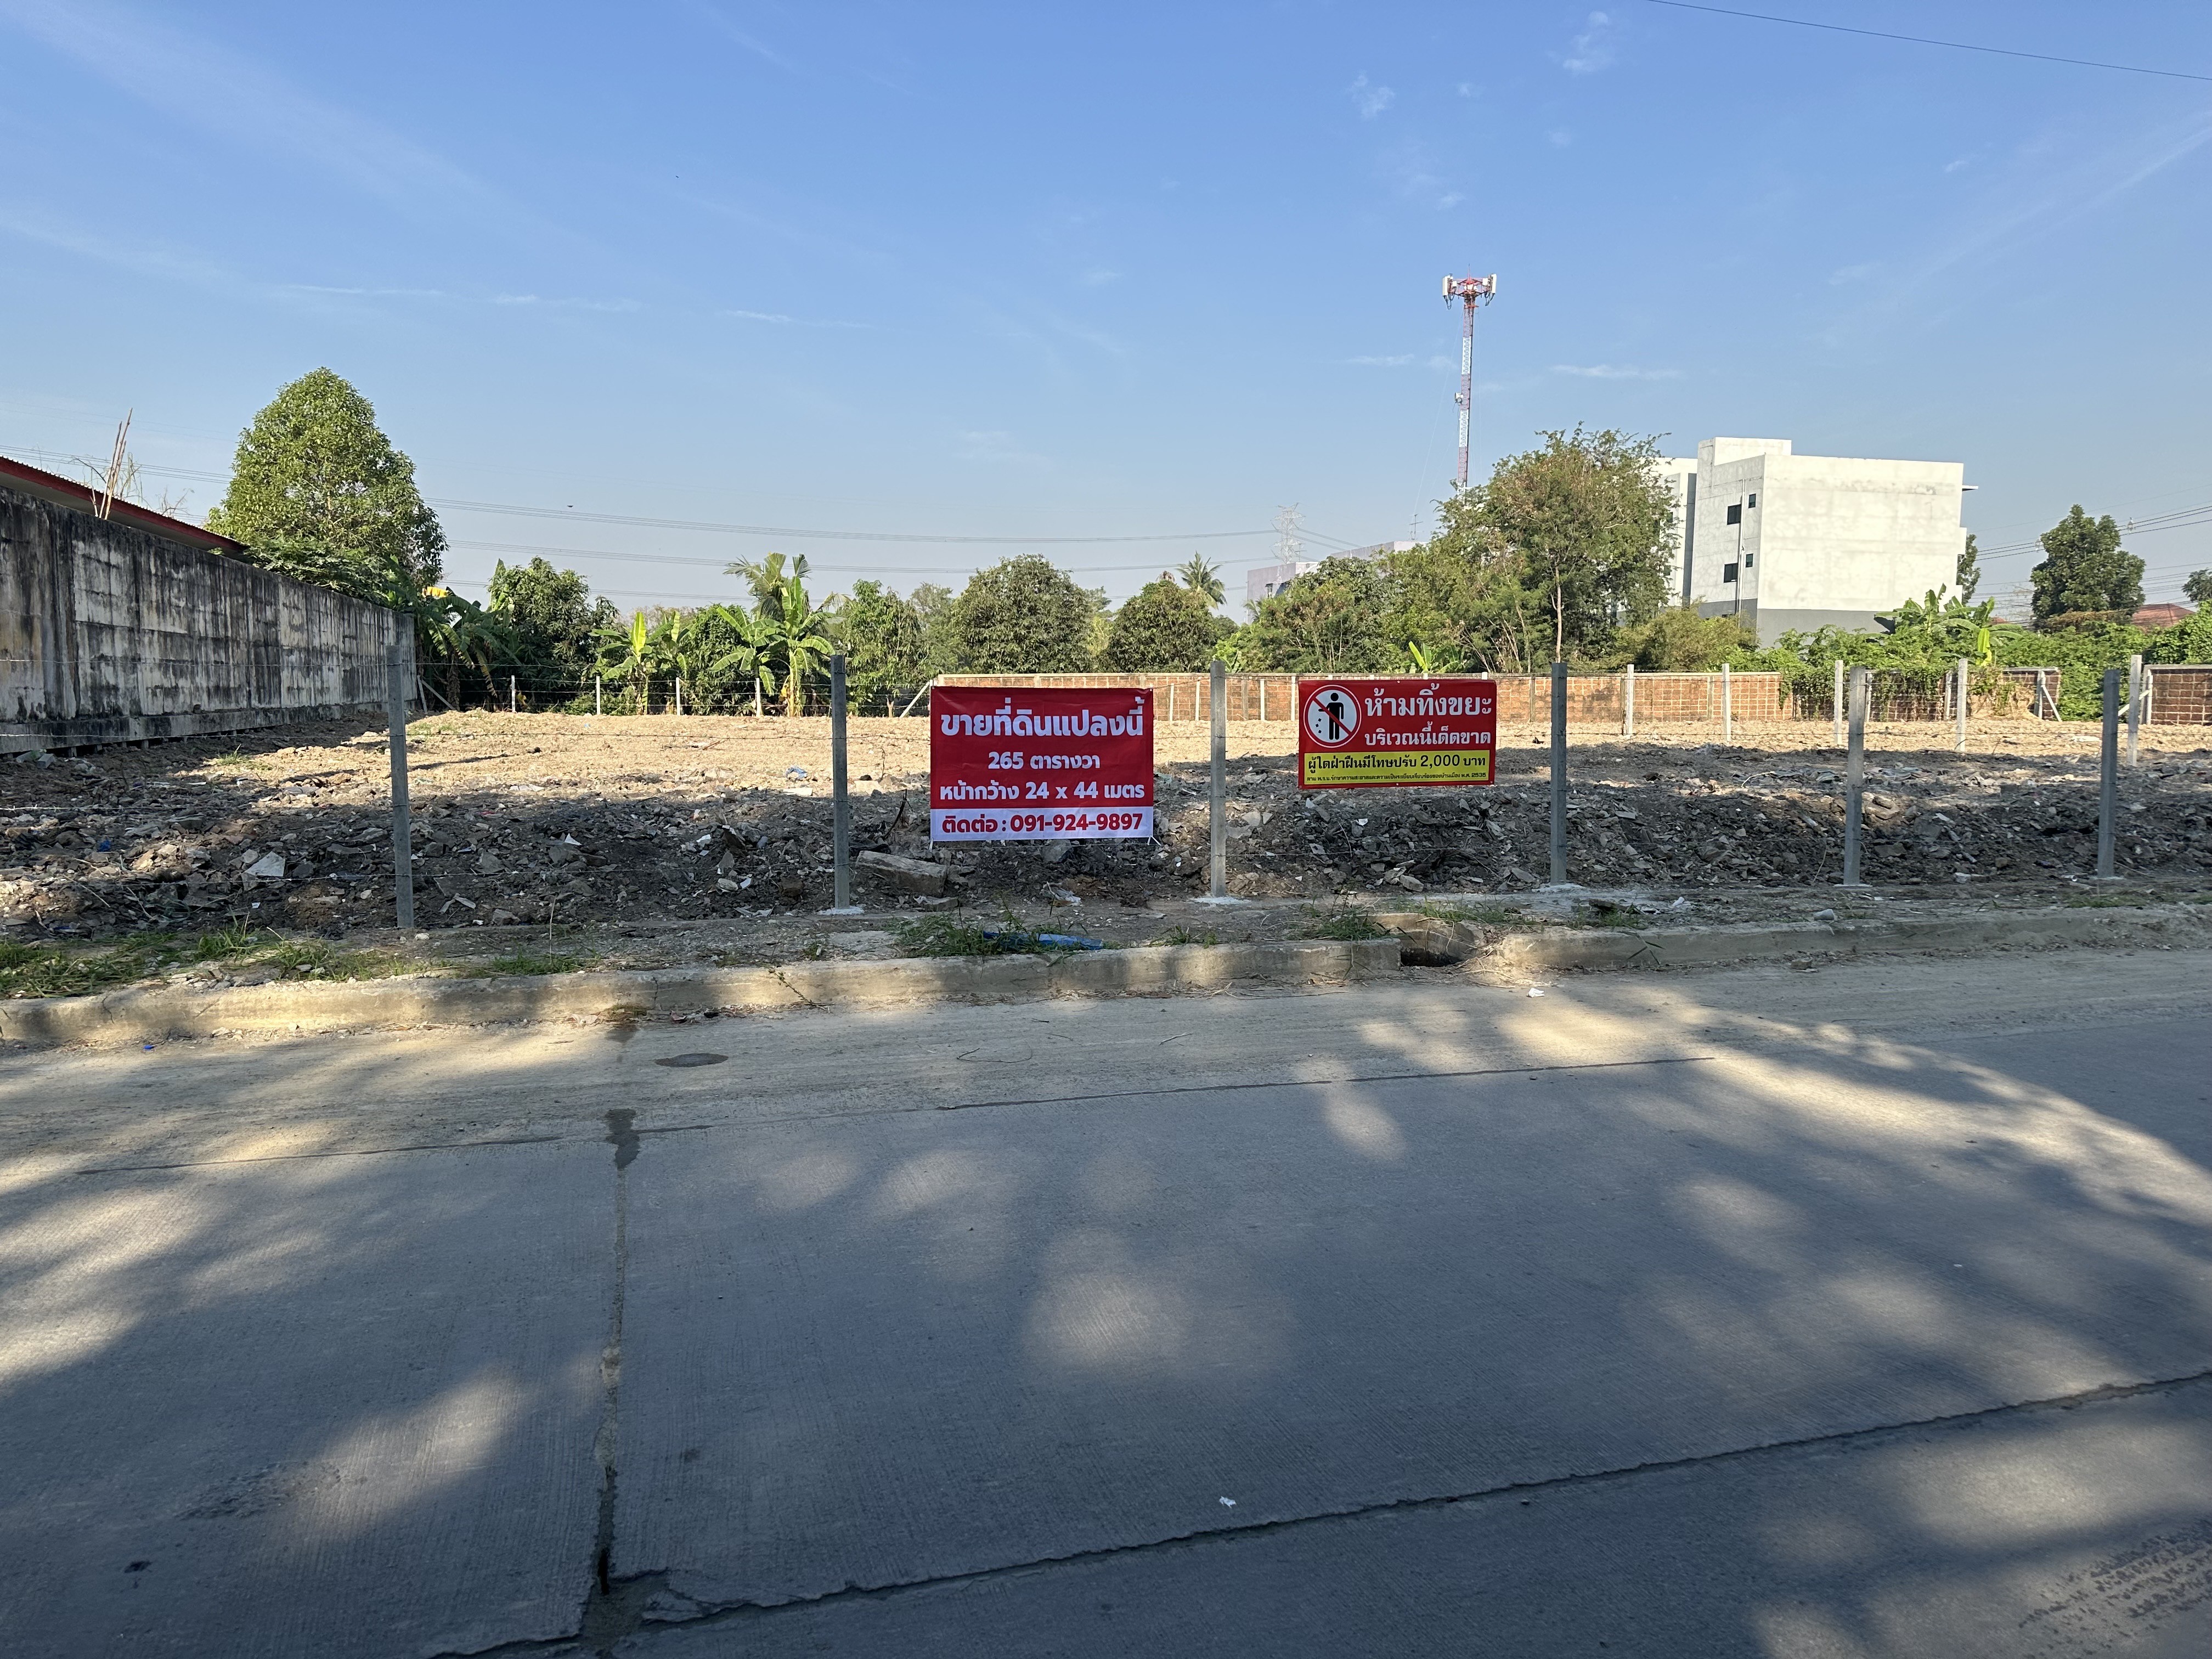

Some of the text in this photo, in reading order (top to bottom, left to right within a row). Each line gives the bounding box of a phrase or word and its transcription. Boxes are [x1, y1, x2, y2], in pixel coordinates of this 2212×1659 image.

[1364, 682, 1492, 716] ห้ามทิ้งขยะ
[941, 697, 1145, 737] ขายที่ดินแปลงนี้
[1364, 721, 1491, 746] บริเวณนี้เด็ดขาด
[988, 752, 1100, 769] 265 ตารางวา
[1308, 754, 1486, 774] ผู้ใดฝ่าฝืนมีโทษปรับ 2,000 บาท
[940, 780, 1145, 800] หน้ากว้าง 24 x 44 เมตร
[942, 814, 998, 833] ติดต่อ
[1010, 813, 1143, 832] 091-924-9897
